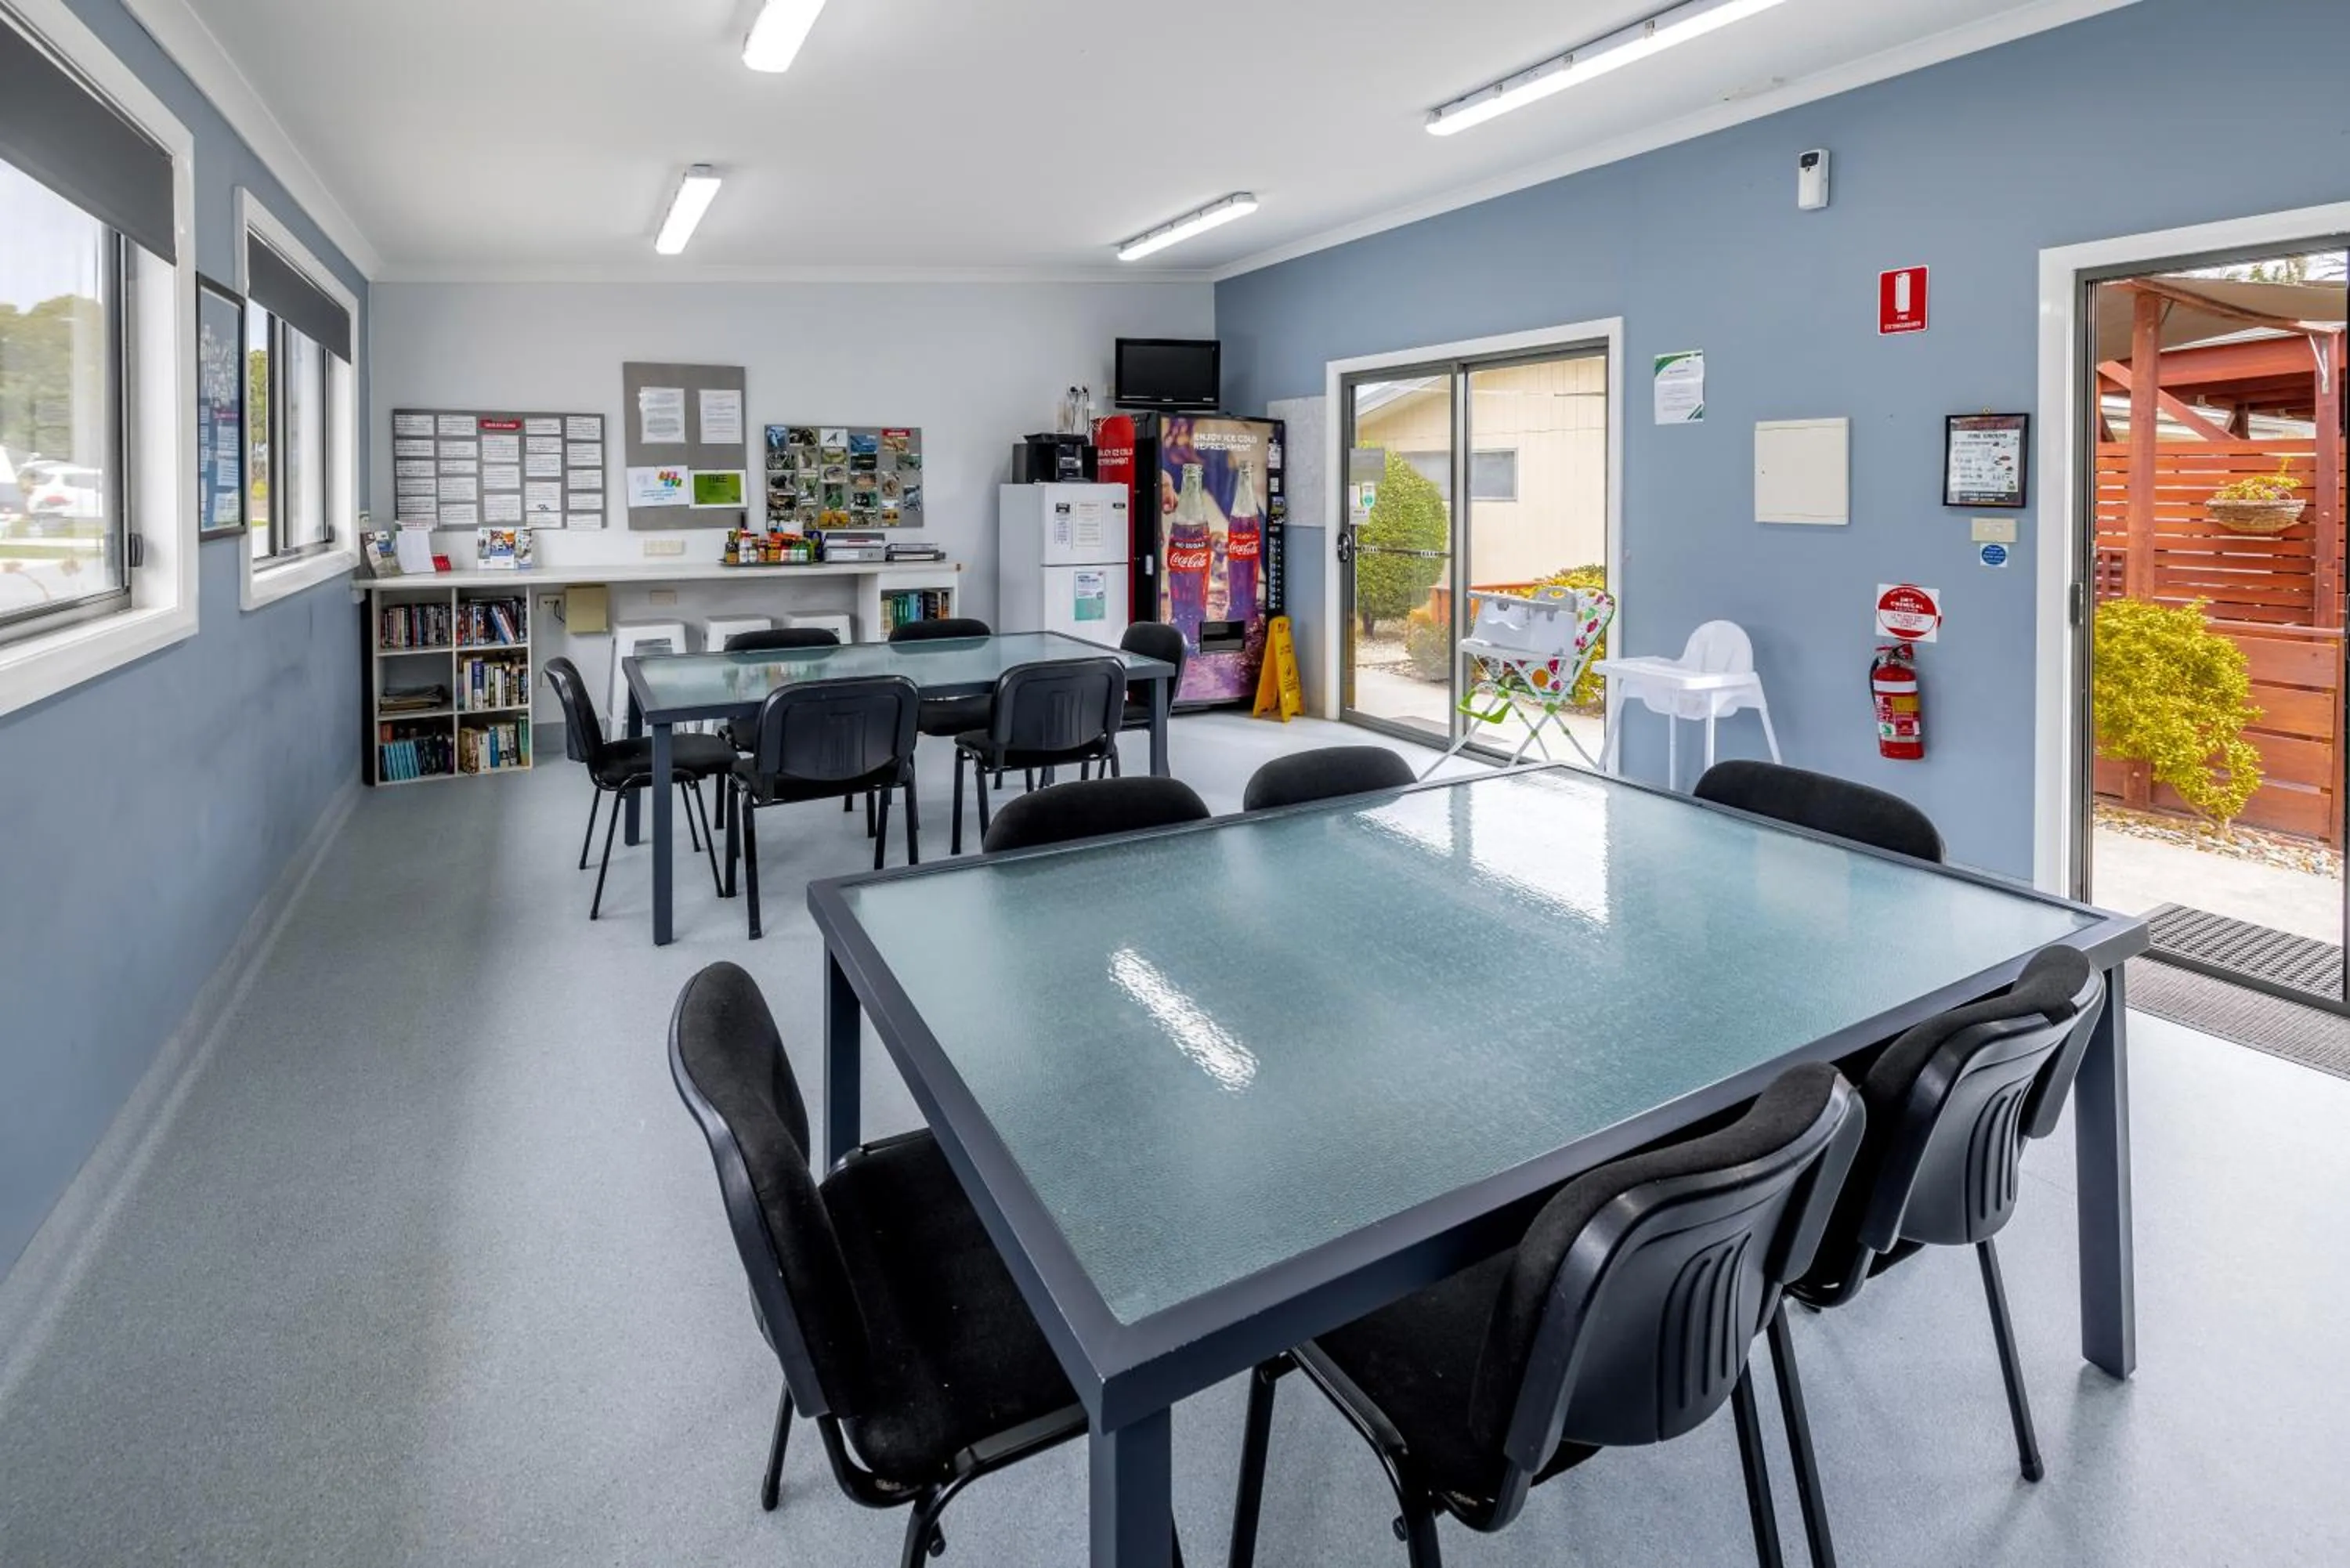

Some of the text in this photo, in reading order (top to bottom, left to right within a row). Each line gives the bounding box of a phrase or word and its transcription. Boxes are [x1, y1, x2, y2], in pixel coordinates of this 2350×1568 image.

[1193, 432, 1257, 443] ENJOY ICE COLD
[1193, 441, 1251, 452] REFRESHMENT
[1170, 551, 1207, 568] Coca-Cola
